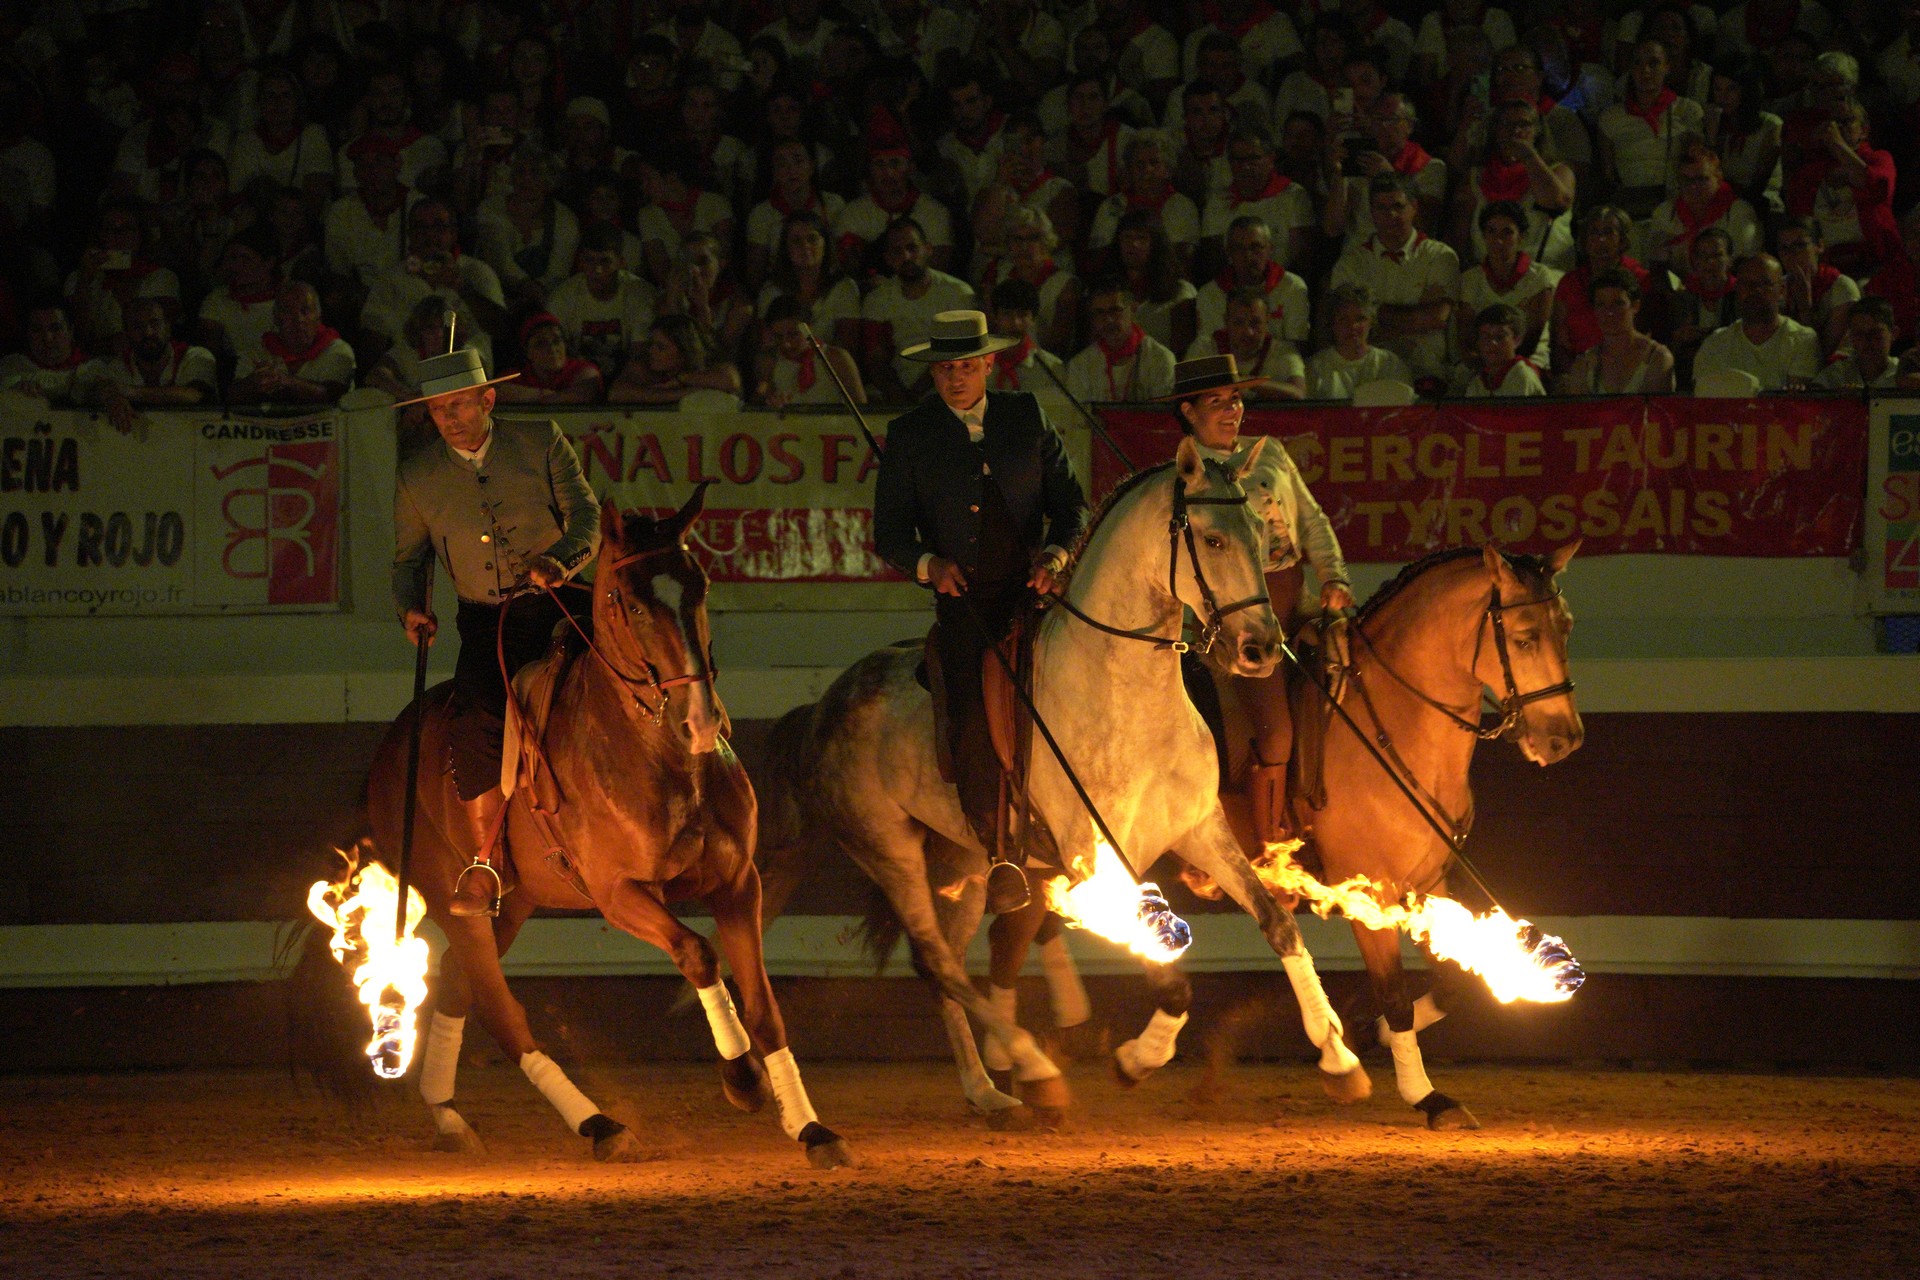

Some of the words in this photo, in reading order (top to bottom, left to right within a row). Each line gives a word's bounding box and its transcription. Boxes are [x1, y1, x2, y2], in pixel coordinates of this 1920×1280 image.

[202, 422, 332, 441] CANDRESSE
[563, 422, 673, 483] ÑA
[684, 432, 804, 484] LOS
[1287, 430, 1545, 484] CERCLE
[1562, 421, 1813, 474] TAURIN
[41, 511, 68, 567] Y
[77, 511, 184, 567] ROJO
[1355, 488, 1732, 547] TYROSSAIS
